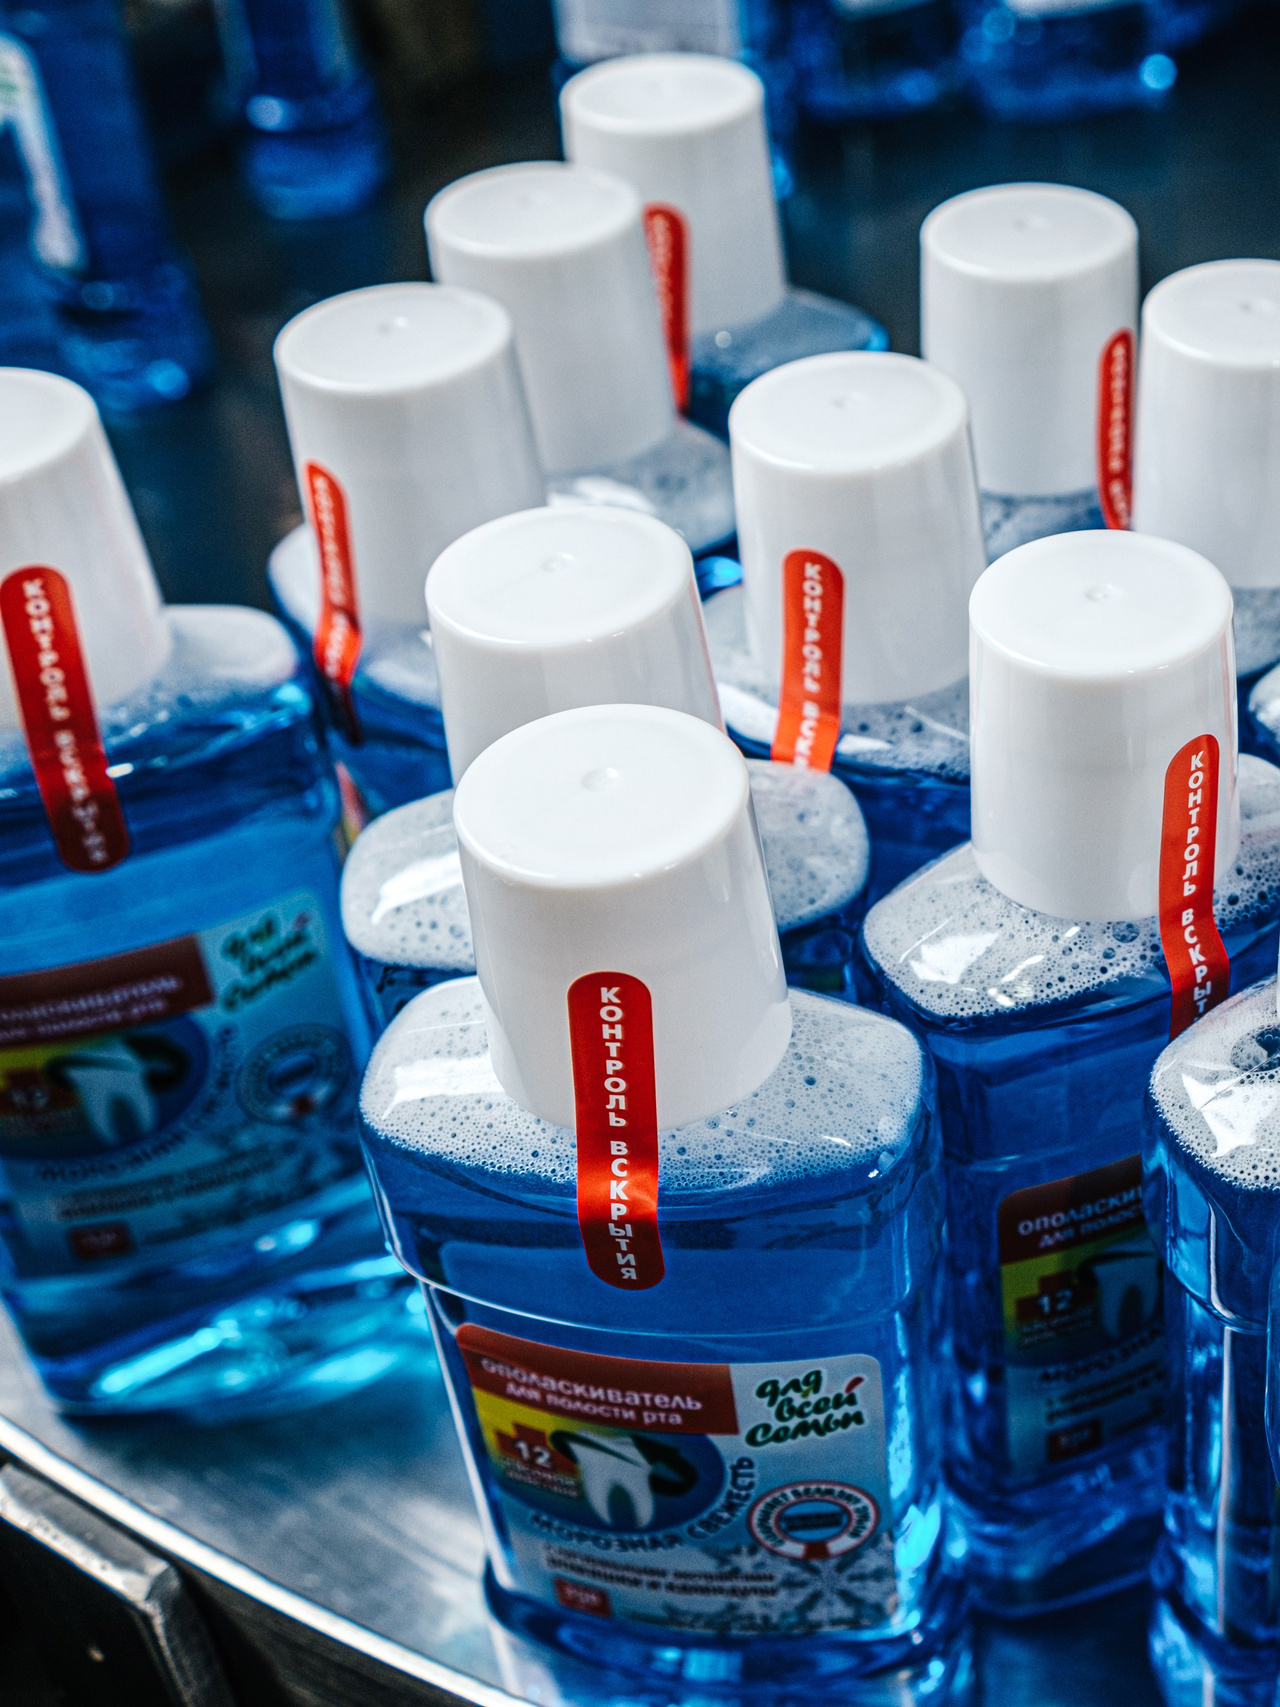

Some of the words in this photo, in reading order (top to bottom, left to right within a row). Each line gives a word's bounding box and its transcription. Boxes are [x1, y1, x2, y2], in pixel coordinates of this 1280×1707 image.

[802, 562, 823, 693] КОНТРОЛЬ
[1181, 750, 1205, 897] КОНТРОЛЬ
[1181, 908, 1212, 1021] ВСКРЫТ
[599, 986, 627, 1128] КОНТРОЛЬ
[608, 1140, 638, 1281] ВСКРЫТИЯ
[480, 1357, 703, 1412] ополаскиватель
[546, 1394, 638, 1421] полости
[642, 1410, 683, 1426] рта
[514, 1440, 552, 1469] 12
[687, 1456, 756, 1540] СВЕЖЕСТЬ
